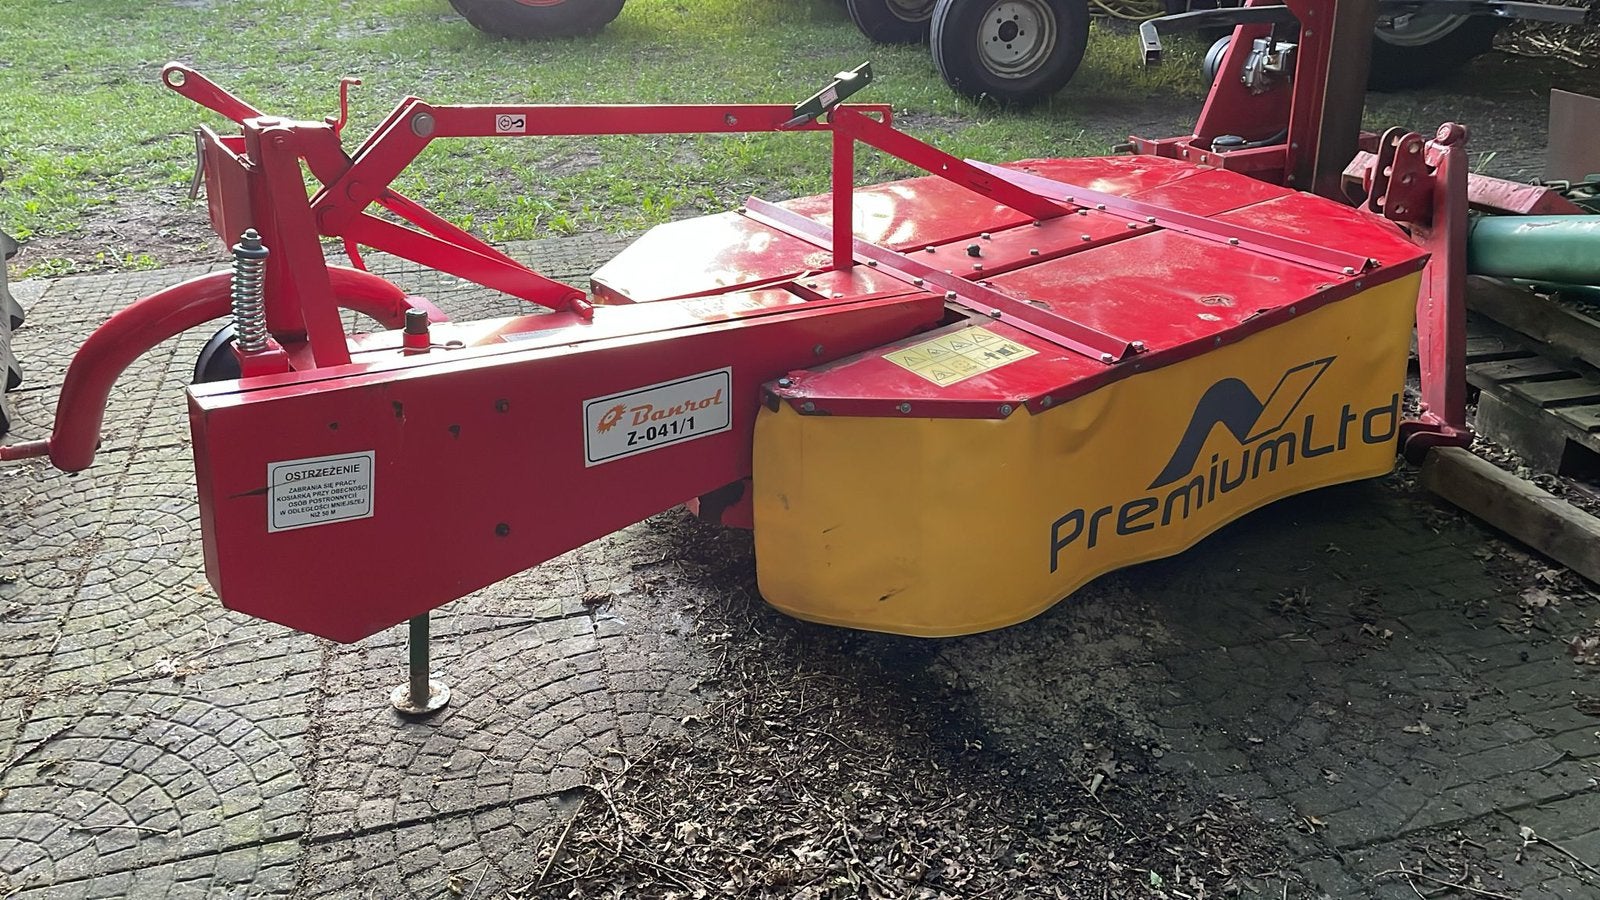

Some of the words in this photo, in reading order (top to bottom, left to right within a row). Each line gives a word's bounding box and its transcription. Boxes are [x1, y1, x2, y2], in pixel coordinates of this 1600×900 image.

[629, 388, 723, 427] Banrol
[627, 416, 695, 447] Z-041/1
[285, 464, 360, 481] OSTRZEŻENIE
[288, 484, 322, 494] ZABRANIA
[335, 479, 357, 487] PRACY
[313, 489, 330, 497] PRZY
[288, 499, 308, 508] OSÓB
[330, 497, 365, 509] MNIEJSZEJ
